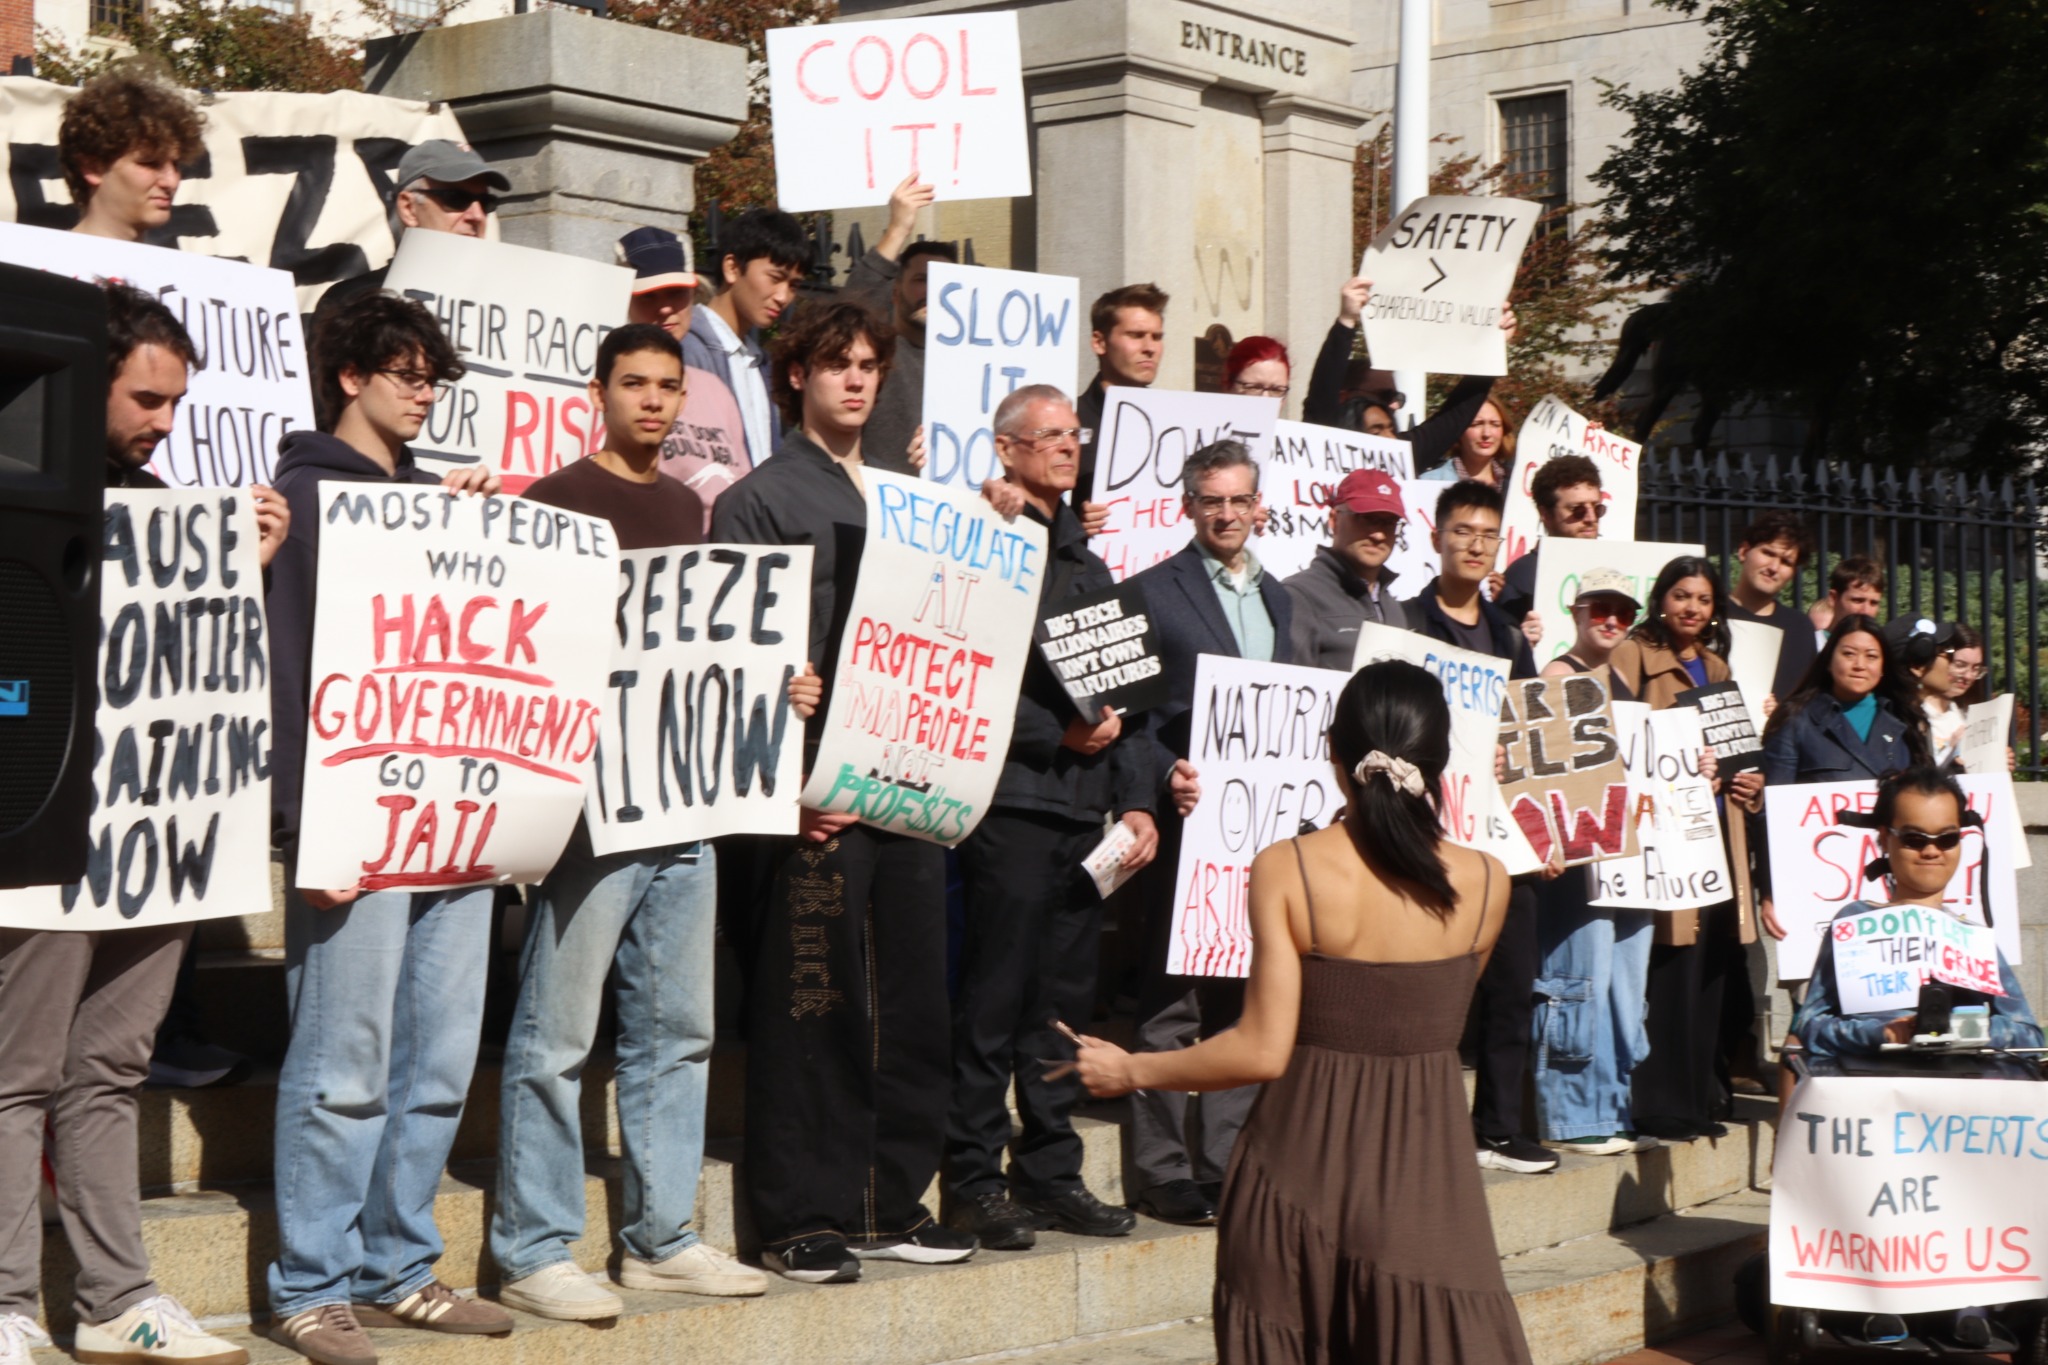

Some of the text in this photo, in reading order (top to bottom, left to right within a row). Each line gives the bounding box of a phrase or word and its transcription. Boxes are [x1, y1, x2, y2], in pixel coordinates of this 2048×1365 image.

[797, 30, 997, 105] COOL
[1181, 20, 1307, 77] ENTRANCE
[866, 123, 962, 188] IT!
[1391, 212, 1517, 252] SAFETY
[936, 282, 1070, 347] SLOW
[1368, 294, 1498, 326] SHAREHOLDER VALUE
[981, 363, 1026, 414] IT
[930, 422, 997, 490] DO
[1269, 434, 1407, 481] AM ALTMAN
[1557, 414, 1571, 439] A
[1583, 421, 1632, 470] RACE
[102, 496, 238, 591] AUSE
[326, 490, 608, 559] MOST PEOPLE
[877, 483, 1039, 595] REGULATE
[427, 550, 506, 588] WHO
[913, 561, 981, 641] AI
[372, 593, 549, 665] HACK
[1073, 598, 1124, 630] TECH
[100, 595, 265, 708] ONTIER
[852, 616, 995, 711] PROTECT
[1082, 654, 1162, 694] FUTURES
[1100, 636, 1146, 667] OWN
[311, 672, 601, 764] GOVERNMENTS
[902, 692, 990, 762] PEOPLE
[1203, 682, 1334, 761] NATURA
[1498, 676, 1607, 727] ARD
[105, 713, 272, 808] AINING
[657, 663, 795, 815] NOW
[379, 754, 499, 796] GO TO
[362, 794, 496, 874] JAIL
[1220, 778, 1326, 855] OVER
[1511, 783, 1628, 865] OW
[1800, 791, 1881, 828] ARE
[61, 812, 220, 919] NOW
[1867, 936, 1938, 965] THEM
[1942, 945, 1998, 986] GRADE
[1942, 918, 1976, 948] LET
[1859, 970, 1913, 997] THEIR
[1797, 1111, 2048, 1160] THE EXPERTS
[1868, 1175, 1941, 1218] ARE
[1791, 1225, 2032, 1274] WARNING US
